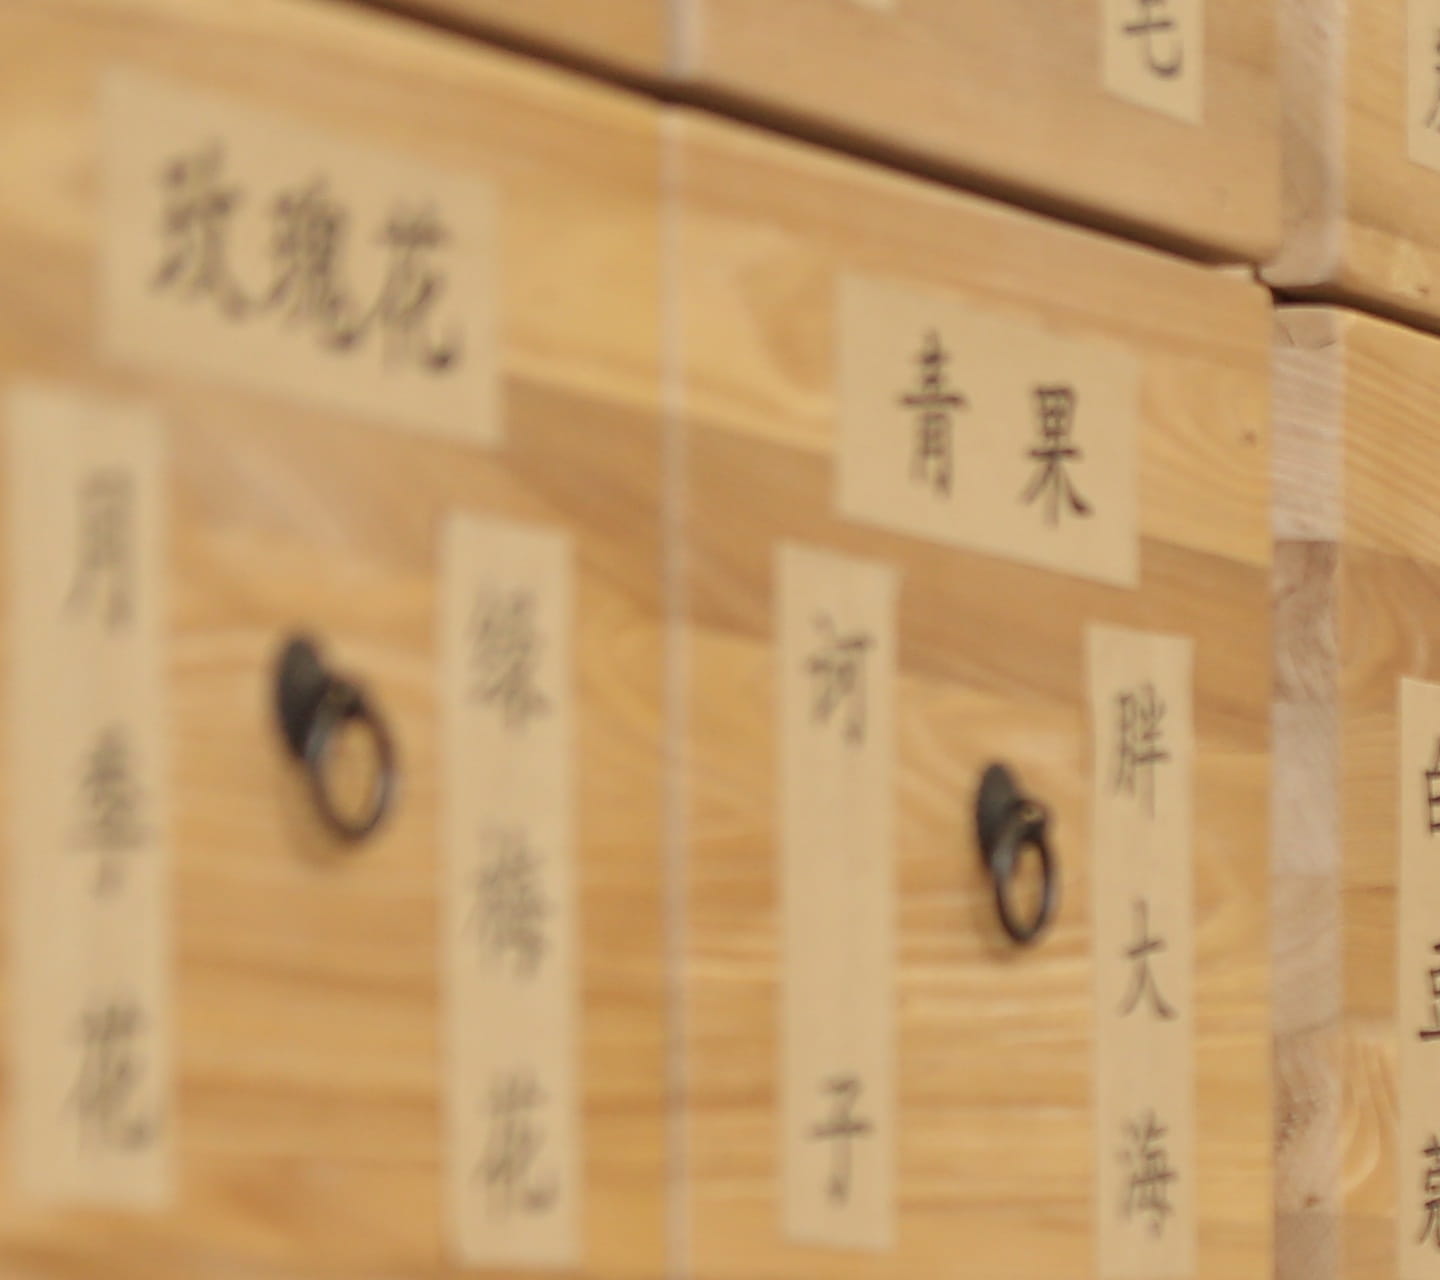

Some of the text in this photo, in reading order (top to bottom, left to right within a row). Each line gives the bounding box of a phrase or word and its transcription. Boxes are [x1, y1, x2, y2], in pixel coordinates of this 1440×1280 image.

[150, 138, 462, 376] 玫瑰花
[900, 330, 1093, 527] 青果
[1113, 683, 1176, 1237] 胖大海
